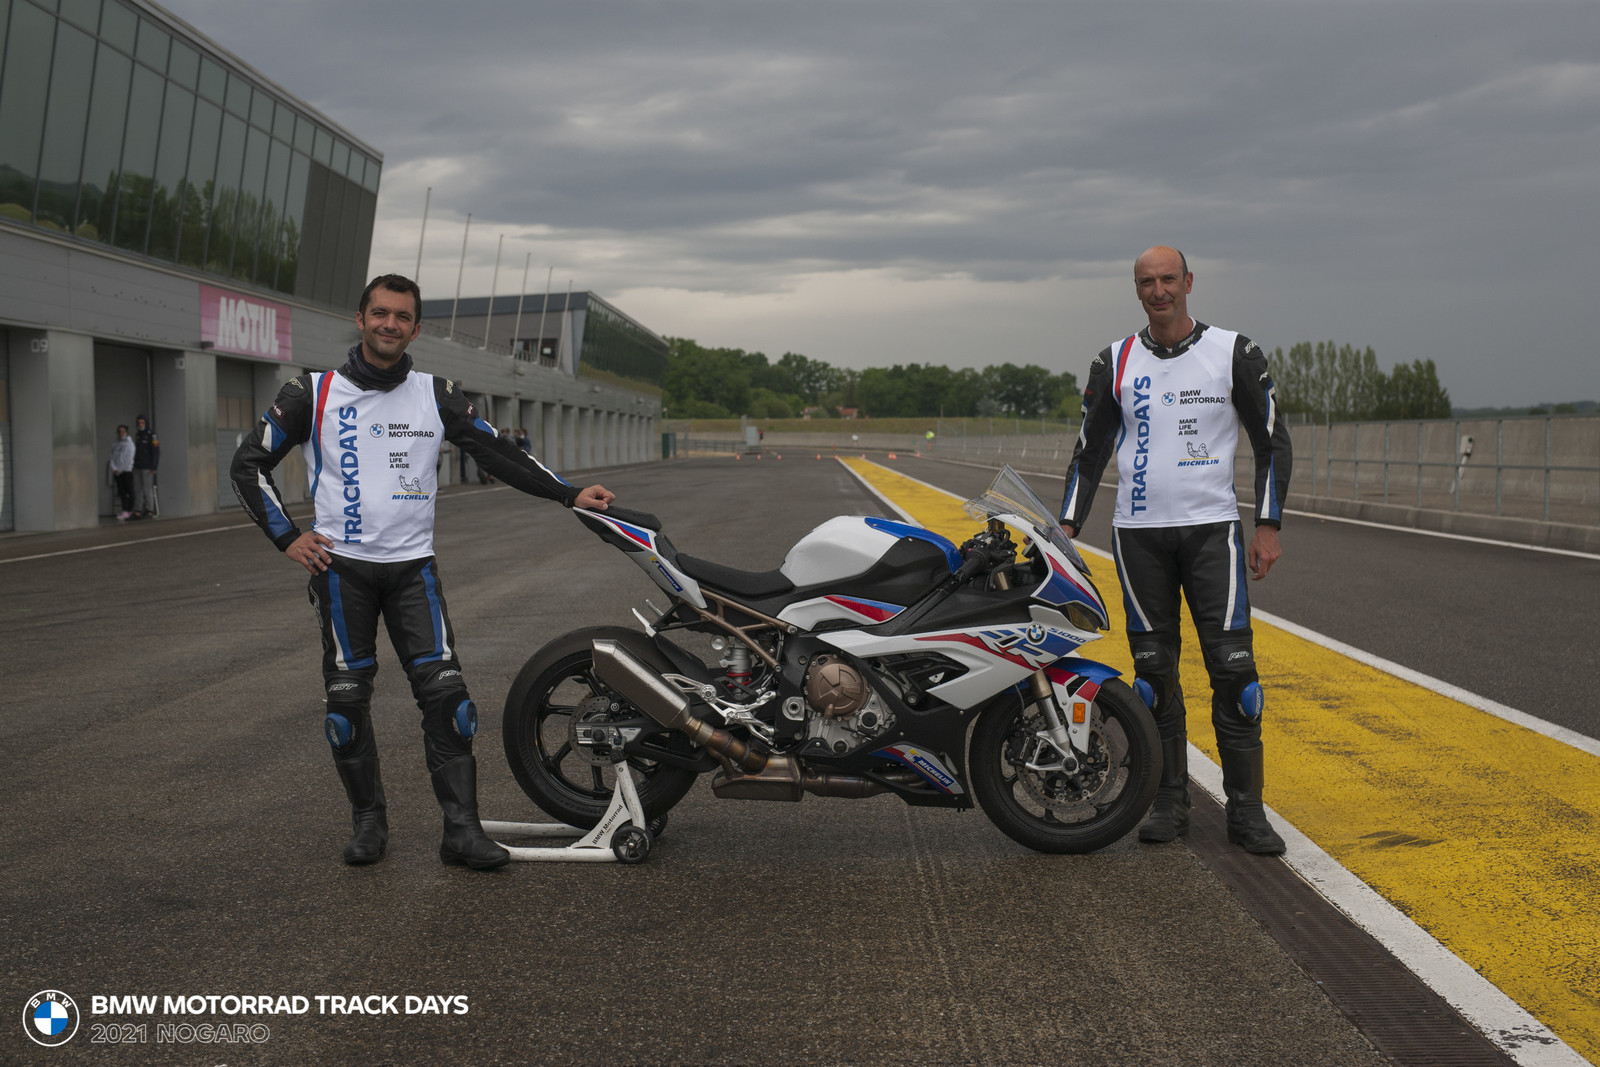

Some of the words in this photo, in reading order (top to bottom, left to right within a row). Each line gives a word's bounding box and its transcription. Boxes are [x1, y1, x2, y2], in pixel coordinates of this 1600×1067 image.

[217, 296, 278, 355] MOTUL
[31, 338, 48, 353] 09
[1179, 390, 1201, 398] BMW
[1179, 396, 1226, 405] MOTORRAD
[1131, 376, 1151, 516] TRACKDAYS
[1177, 459, 1220, 467] MICHELIN
[338, 406, 363, 544] TRACKDAYS
[1047, 627, 1087, 643] S1000
[329, 683, 358, 692] RST
[918, 760, 952, 785] MICHELIN
[592, 829, 605, 845] BMW
[603, 804, 623, 830] Motorrad
